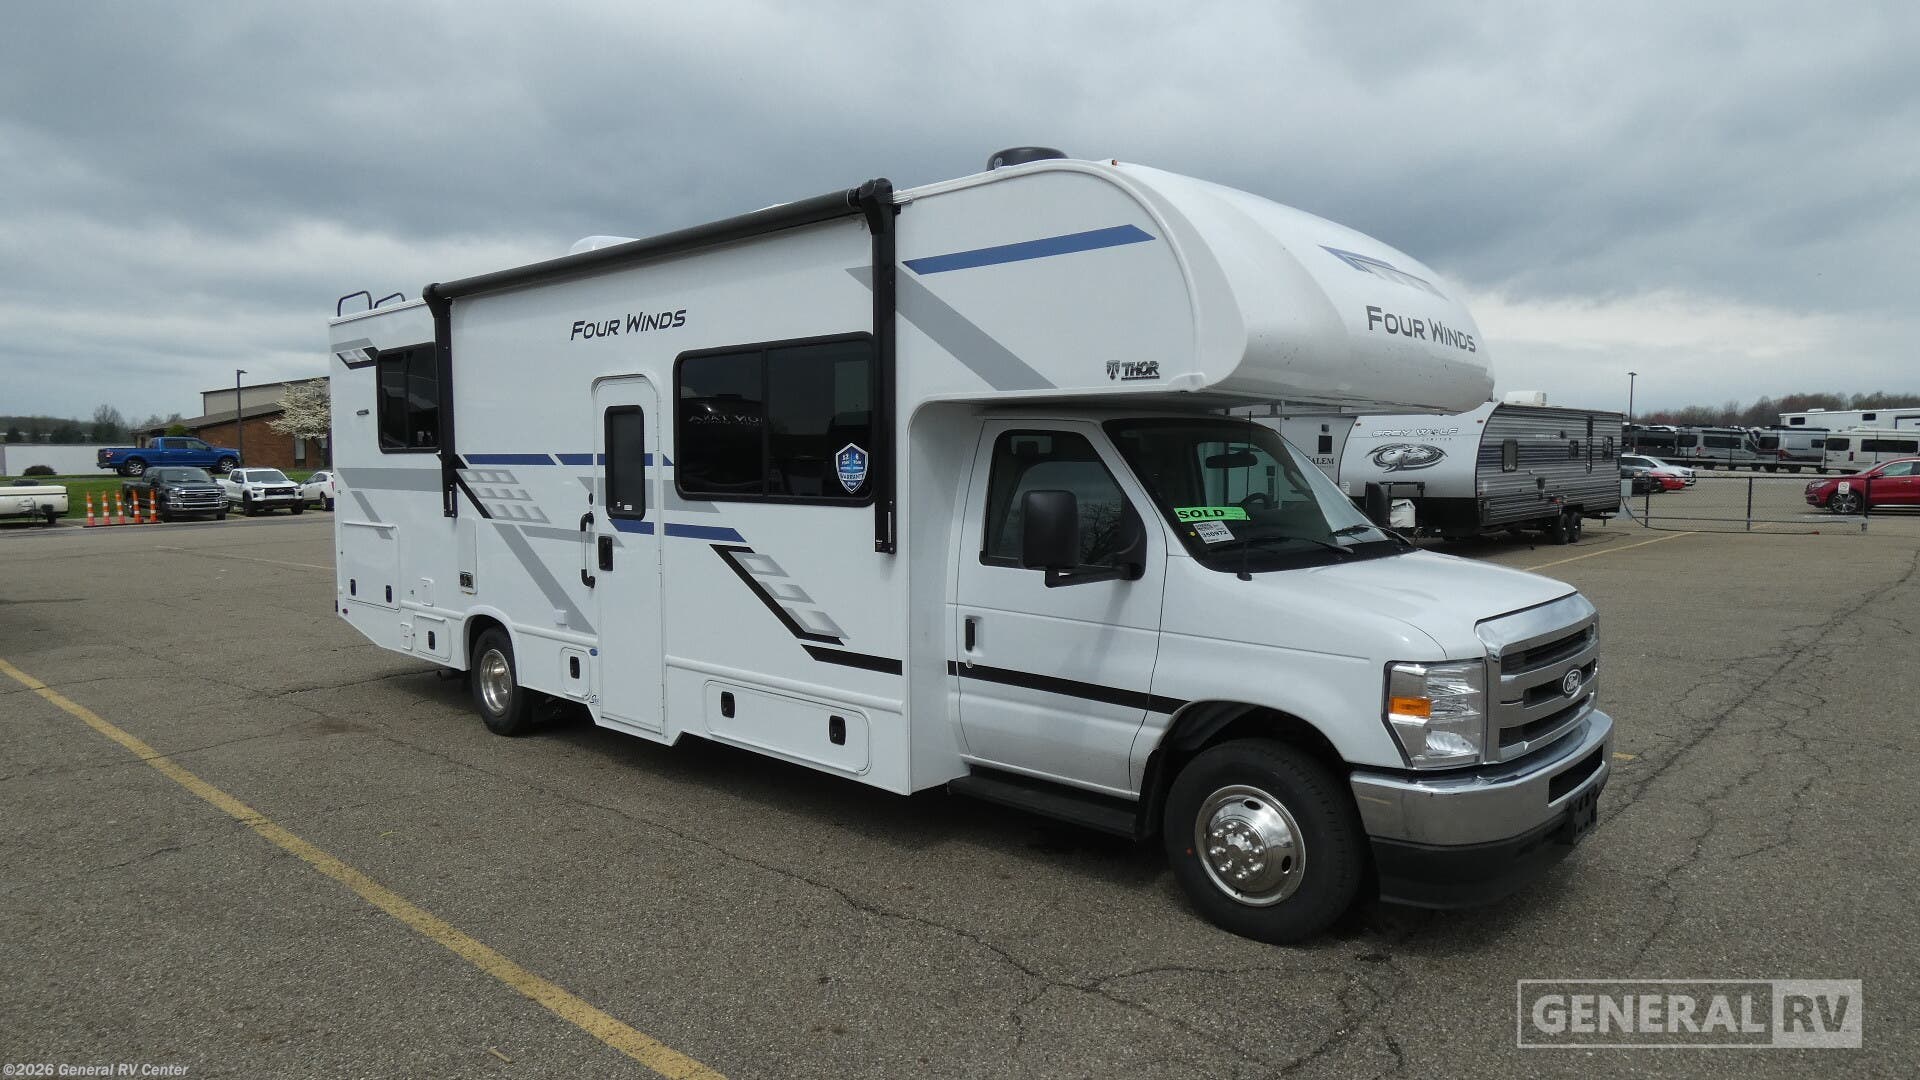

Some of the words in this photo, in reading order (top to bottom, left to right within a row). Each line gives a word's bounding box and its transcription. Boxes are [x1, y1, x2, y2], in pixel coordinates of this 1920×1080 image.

[570, 320, 621, 341] FOUR
[626, 309, 687, 335] WINDS
[1366, 305, 1426, 340] FOUR
[1428, 318, 1476, 353] WINDS
[1121, 360, 1160, 377] THOR
[1177, 509, 1225, 519] SOLD
